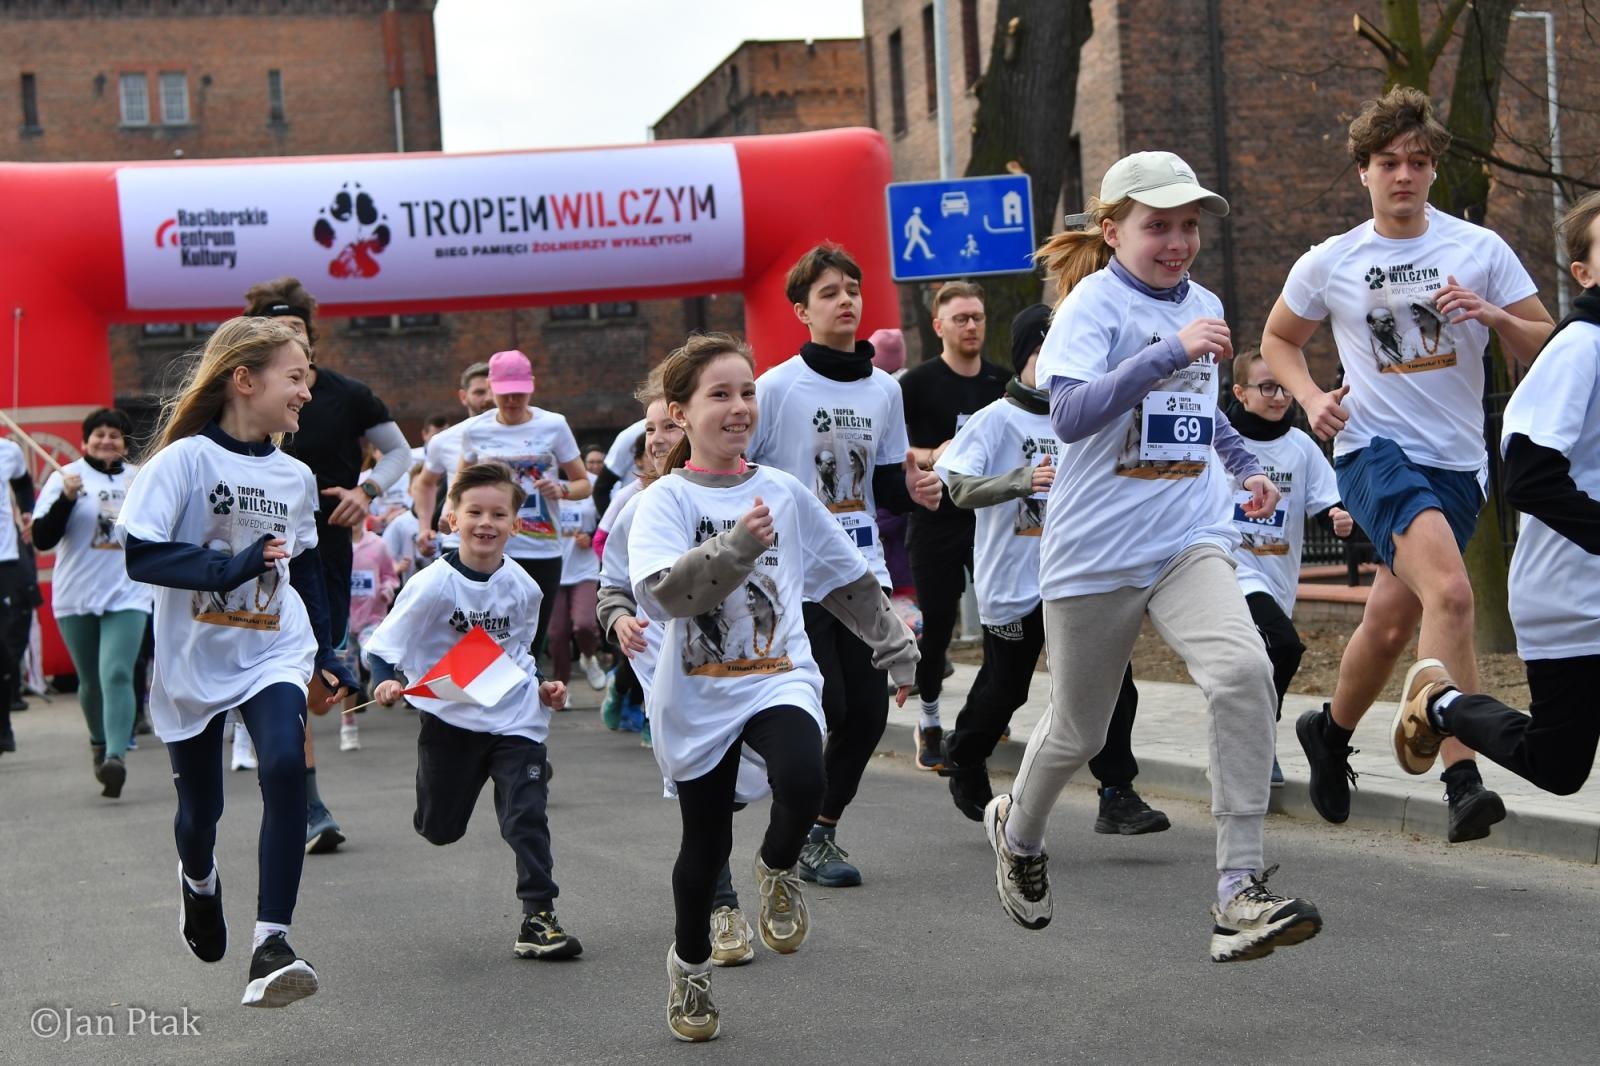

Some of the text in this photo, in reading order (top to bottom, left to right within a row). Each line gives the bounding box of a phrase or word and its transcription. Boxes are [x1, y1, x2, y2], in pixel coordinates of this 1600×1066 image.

[177, 208, 269, 228] Raciborskie
[434, 233, 693, 259] BIEG PAMIĘCI ŻOŁNIERZY WYKLĘTYCH
[181, 249, 238, 269] Kultury
[1388, 267, 1439, 283] WILCZYM
[1425, 282, 1442, 292] 2026
[834, 415, 872, 428] WILCZYM
[1173, 416, 1201, 442] 69
[1039, 444, 1059, 456] WILC
[237, 485, 266, 498] TROPEM
[238, 495, 289, 518] WILCZYM
[238, 518, 250, 528] XIV
[250, 519, 273, 530] EDYCJA
[764, 556, 779, 567] 2026
